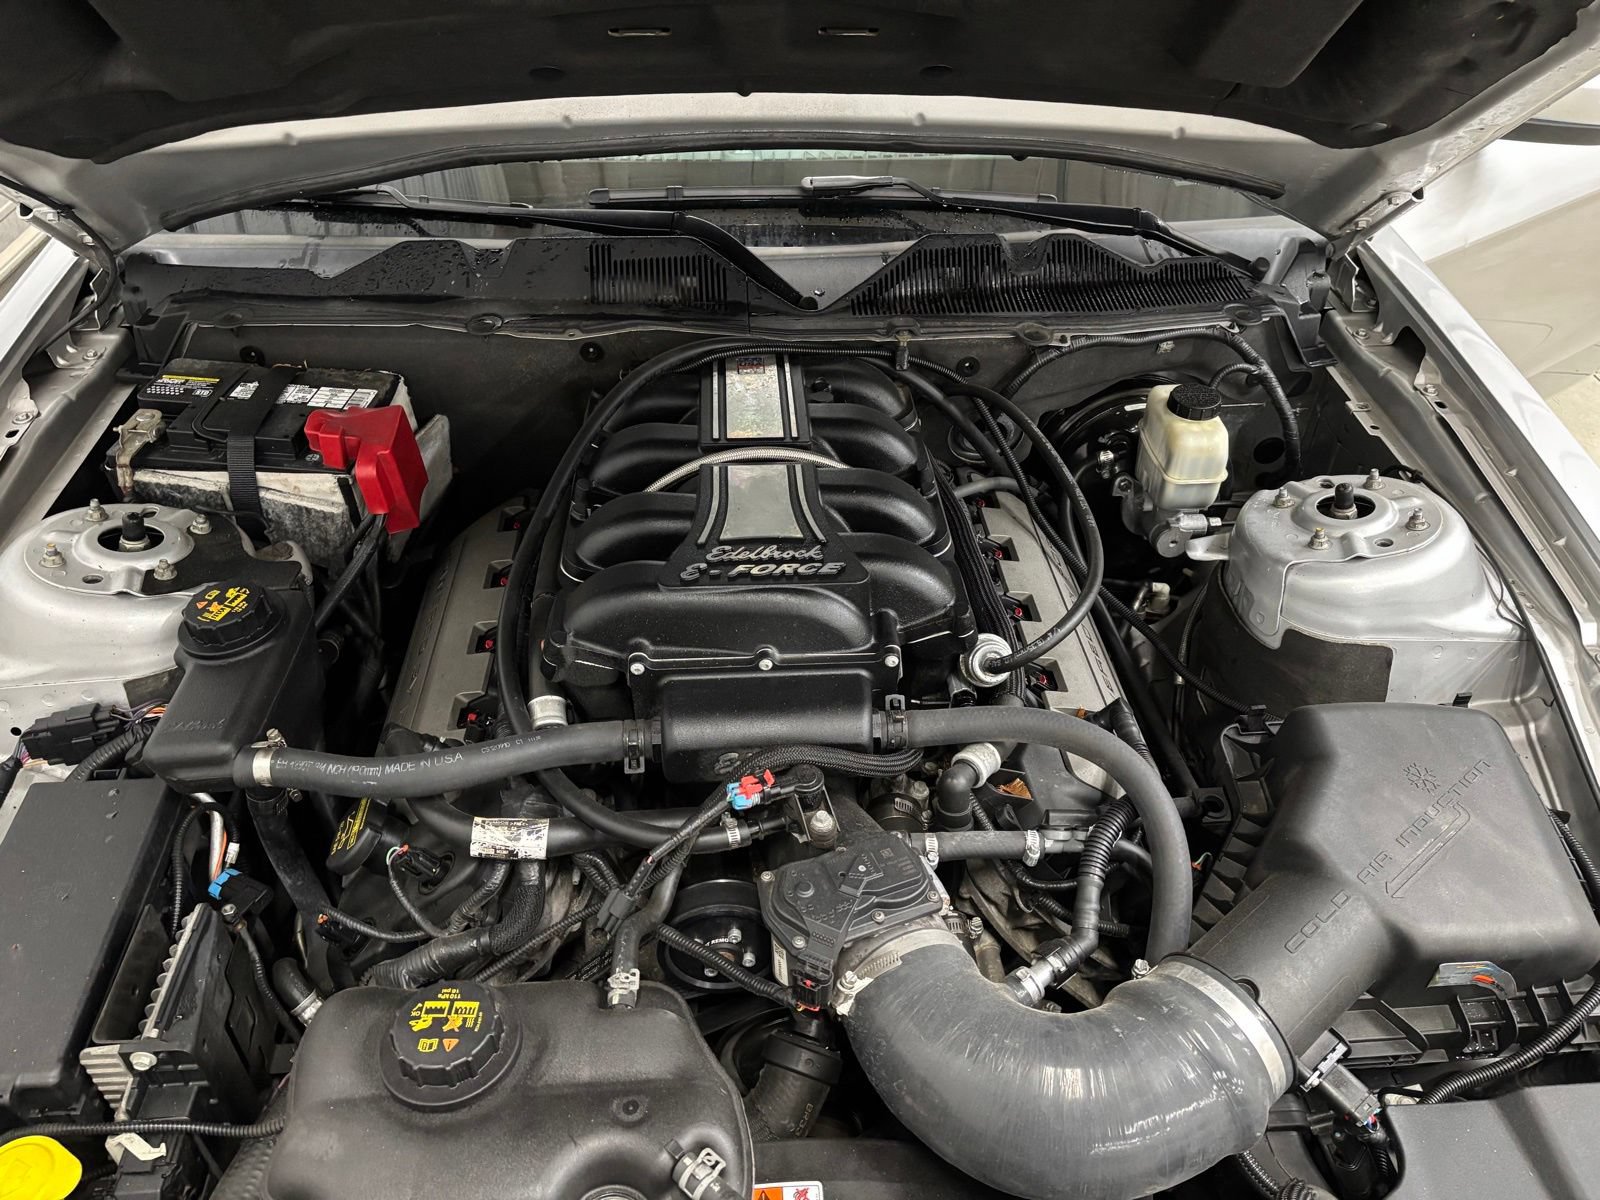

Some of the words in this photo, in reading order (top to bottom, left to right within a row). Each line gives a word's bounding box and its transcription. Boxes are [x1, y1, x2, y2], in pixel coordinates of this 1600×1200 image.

[705, 544, 824, 562] Edelbrock
[1079, 623, 1115, 694] ERED
[385, 760, 416, 775] MADE
[1284, 888, 1352, 954] COLD
[1356, 849, 1394, 885] AIR
[1395, 758, 1492, 848] INDUCTION
[710, 937, 729, 945] REMO
